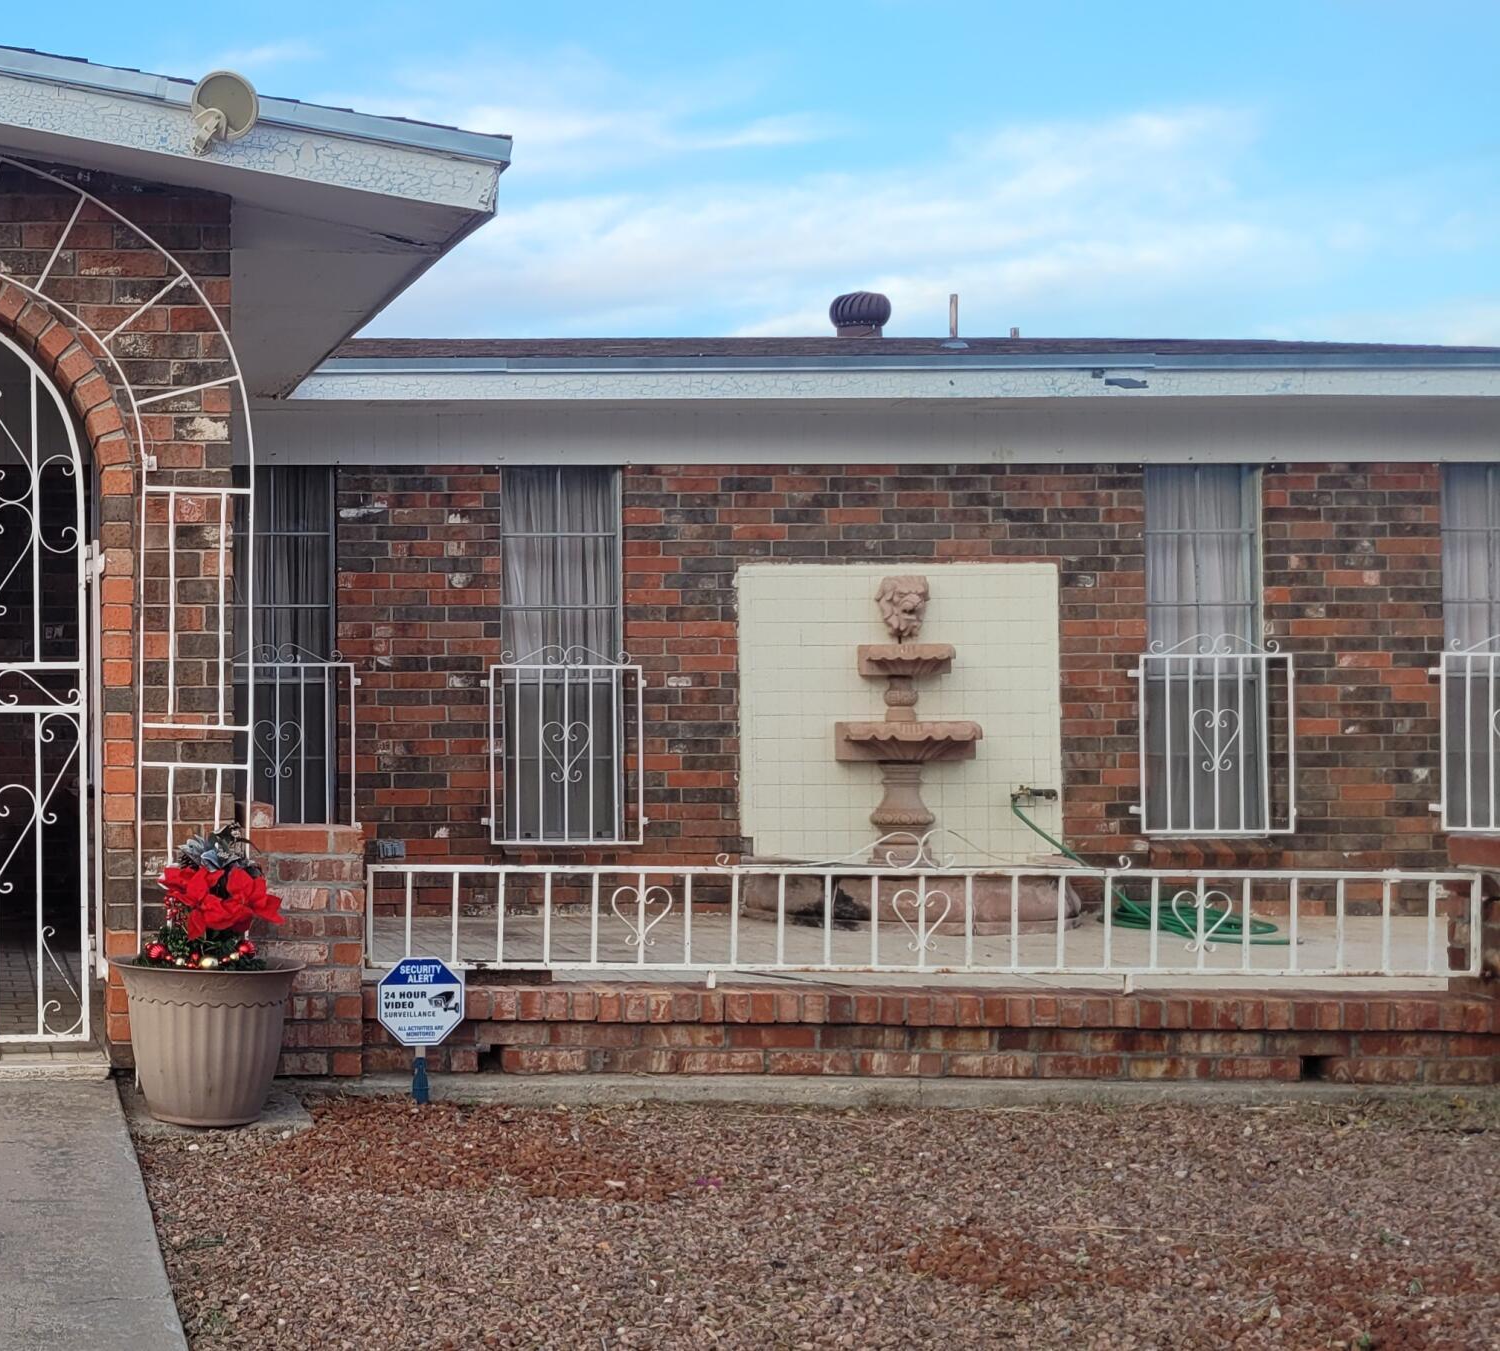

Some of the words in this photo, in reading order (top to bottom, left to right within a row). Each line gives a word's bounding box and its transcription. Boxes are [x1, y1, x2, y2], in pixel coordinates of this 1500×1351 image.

[400, 965, 441, 974] SECURITY
[407, 974, 434, 983] ALERT
[399, 991, 427, 999] HOUR
[384, 1001, 414, 1009] VIDEO
[384, 1010, 436, 1018] SURVEILLANCE
